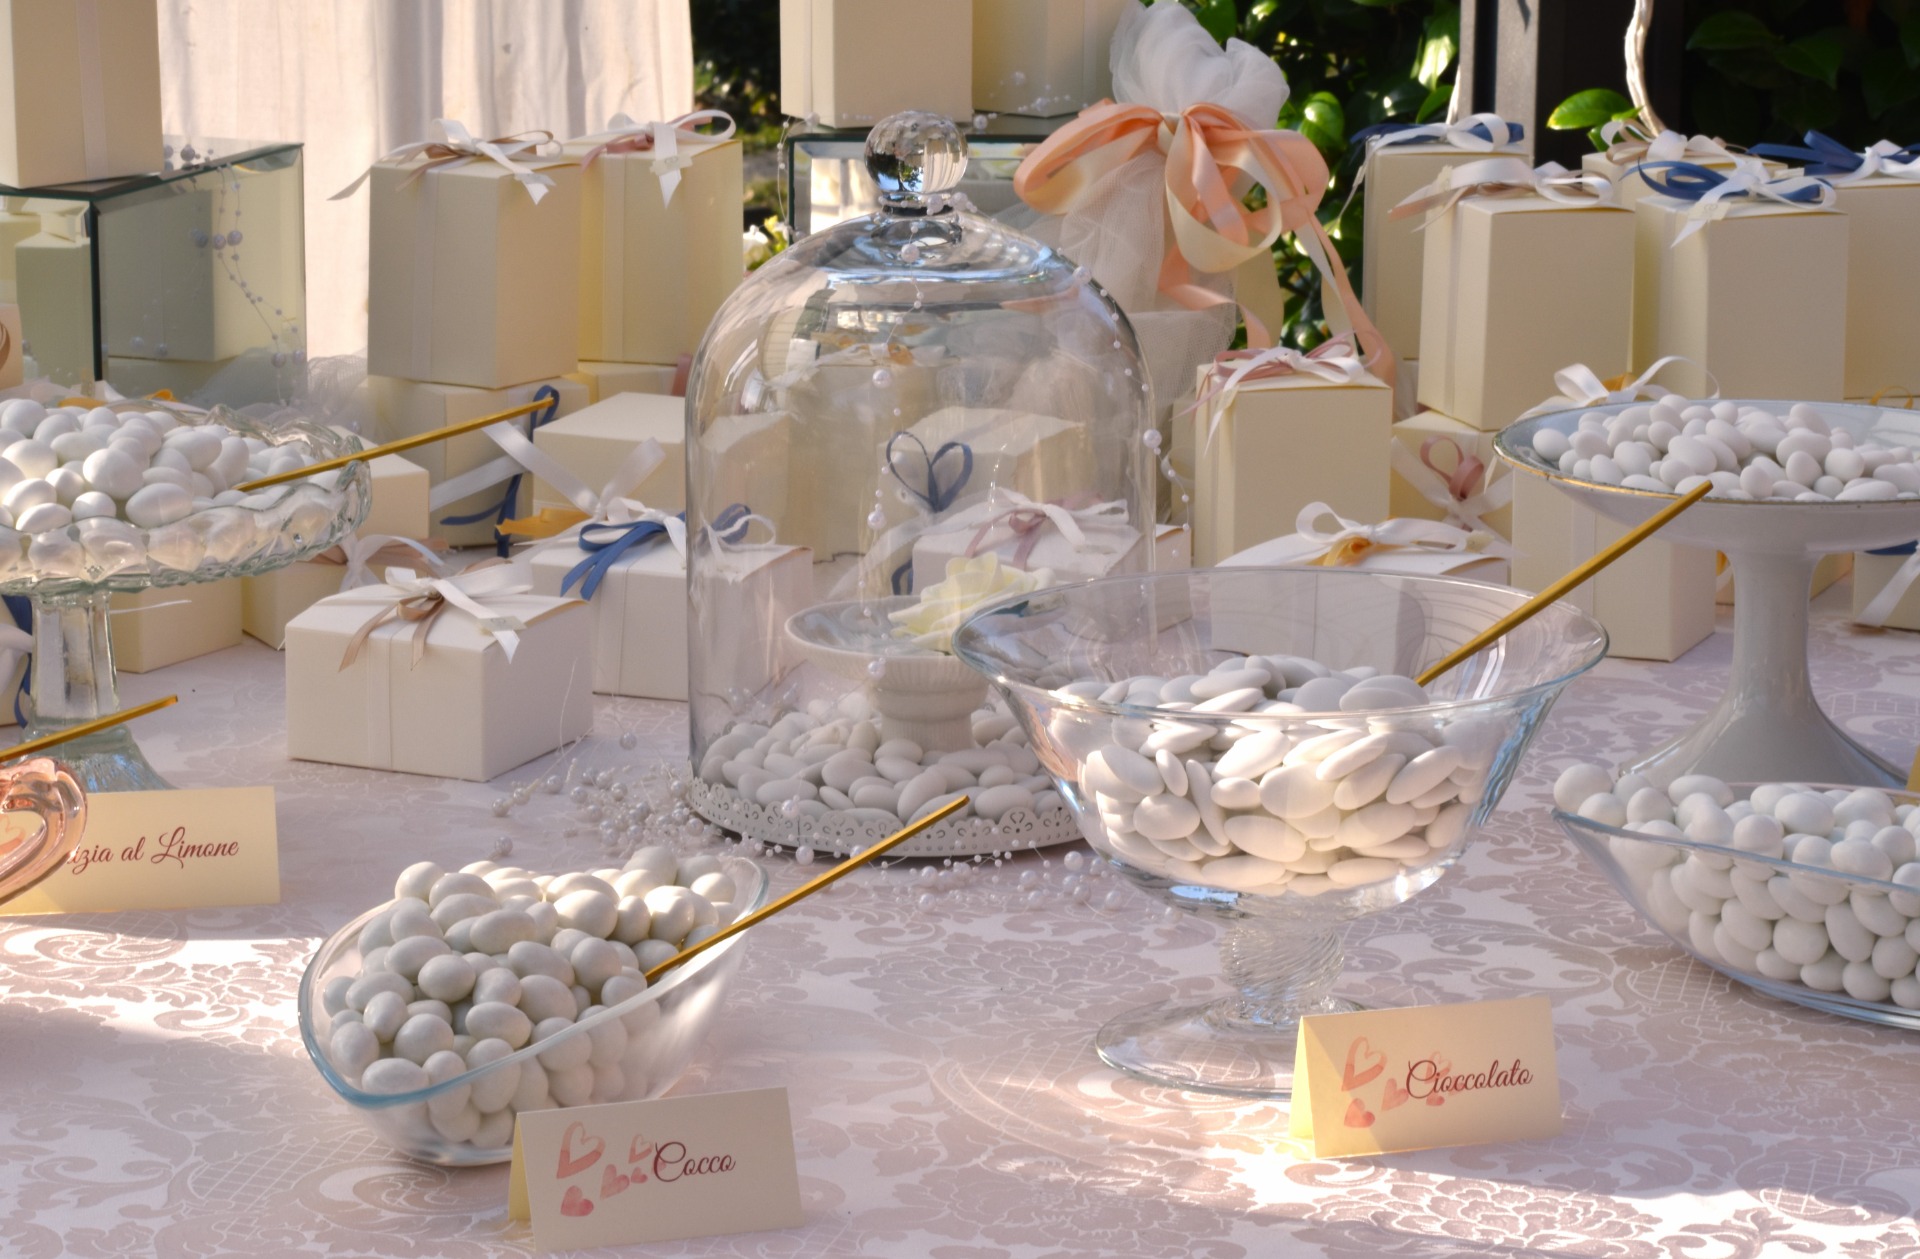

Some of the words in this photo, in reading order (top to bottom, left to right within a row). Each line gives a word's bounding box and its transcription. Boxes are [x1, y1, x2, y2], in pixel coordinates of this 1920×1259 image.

[67, 844, 114, 876] izia
[120, 836, 146, 862] al
[150, 826, 240, 870] Limone
[1405, 1058, 1534, 1099] Cioccolato
[653, 1141, 736, 1183] Cocco
